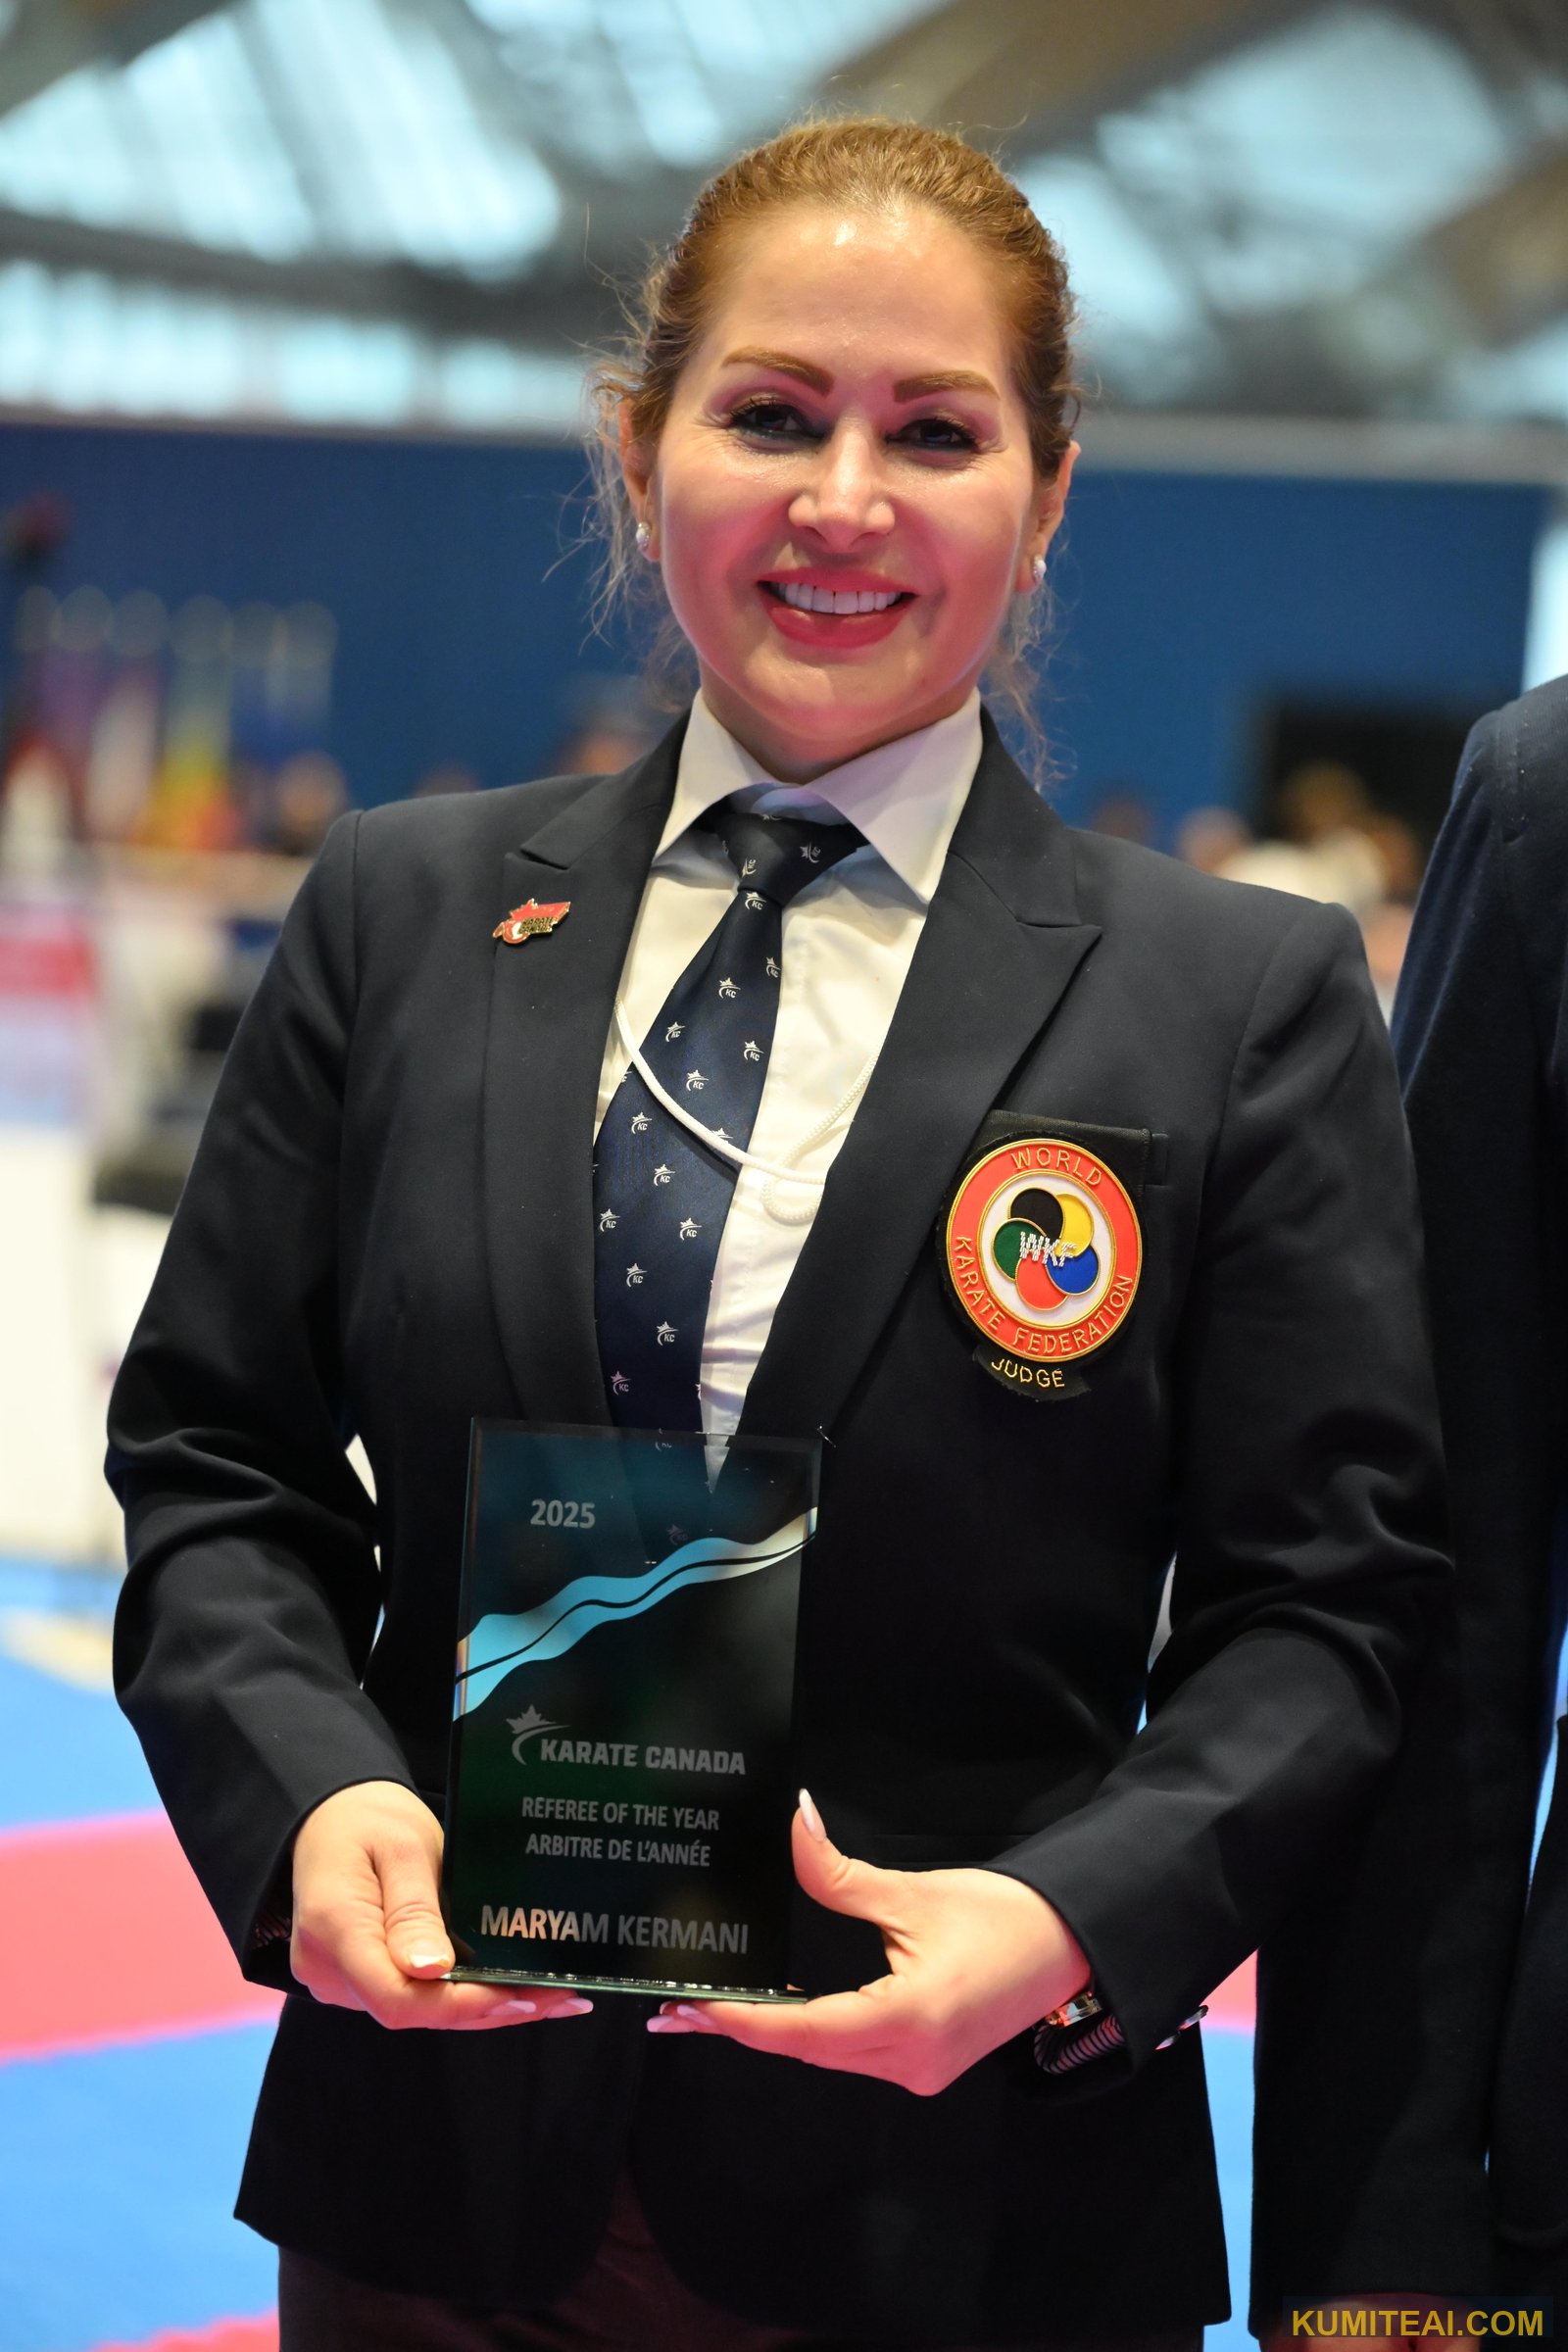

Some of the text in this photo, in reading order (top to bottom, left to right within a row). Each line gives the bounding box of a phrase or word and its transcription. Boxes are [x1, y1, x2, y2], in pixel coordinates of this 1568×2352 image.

[752, 900, 763, 910] KC
[769, 968, 779, 978] KC
[725, 988, 737, 999] KC
[670, 1030, 681, 1039] KC
[750, 1051, 760, 1061] KC
[693, 1080, 705, 1090] KC
[637, 1122, 648, 1131] KC
[1011, 1147, 1102, 1187] WORLD
[606, 1220, 616, 1229] KC
[686, 1229, 698, 1238] KC
[1019, 1231, 1077, 1267] WKF
[632, 1275, 644, 1284] KC
[954, 1235, 1133, 1353] KARATE FEDERATION
[663, 1333, 675, 1343] KC
[991, 1358, 1065, 1388] JUDGE
[618, 1383, 630, 1393] KC
[530, 1499, 596, 1529] 2025
[540, 1739, 746, 1776] KARATE CANADA
[521, 1796, 719, 1831] REFEREE OF THE YEAR
[524, 1833, 710, 1867] ARBITRE DE L'ANNÉE
[480, 1905, 749, 1954] MARYAM KERMANI
